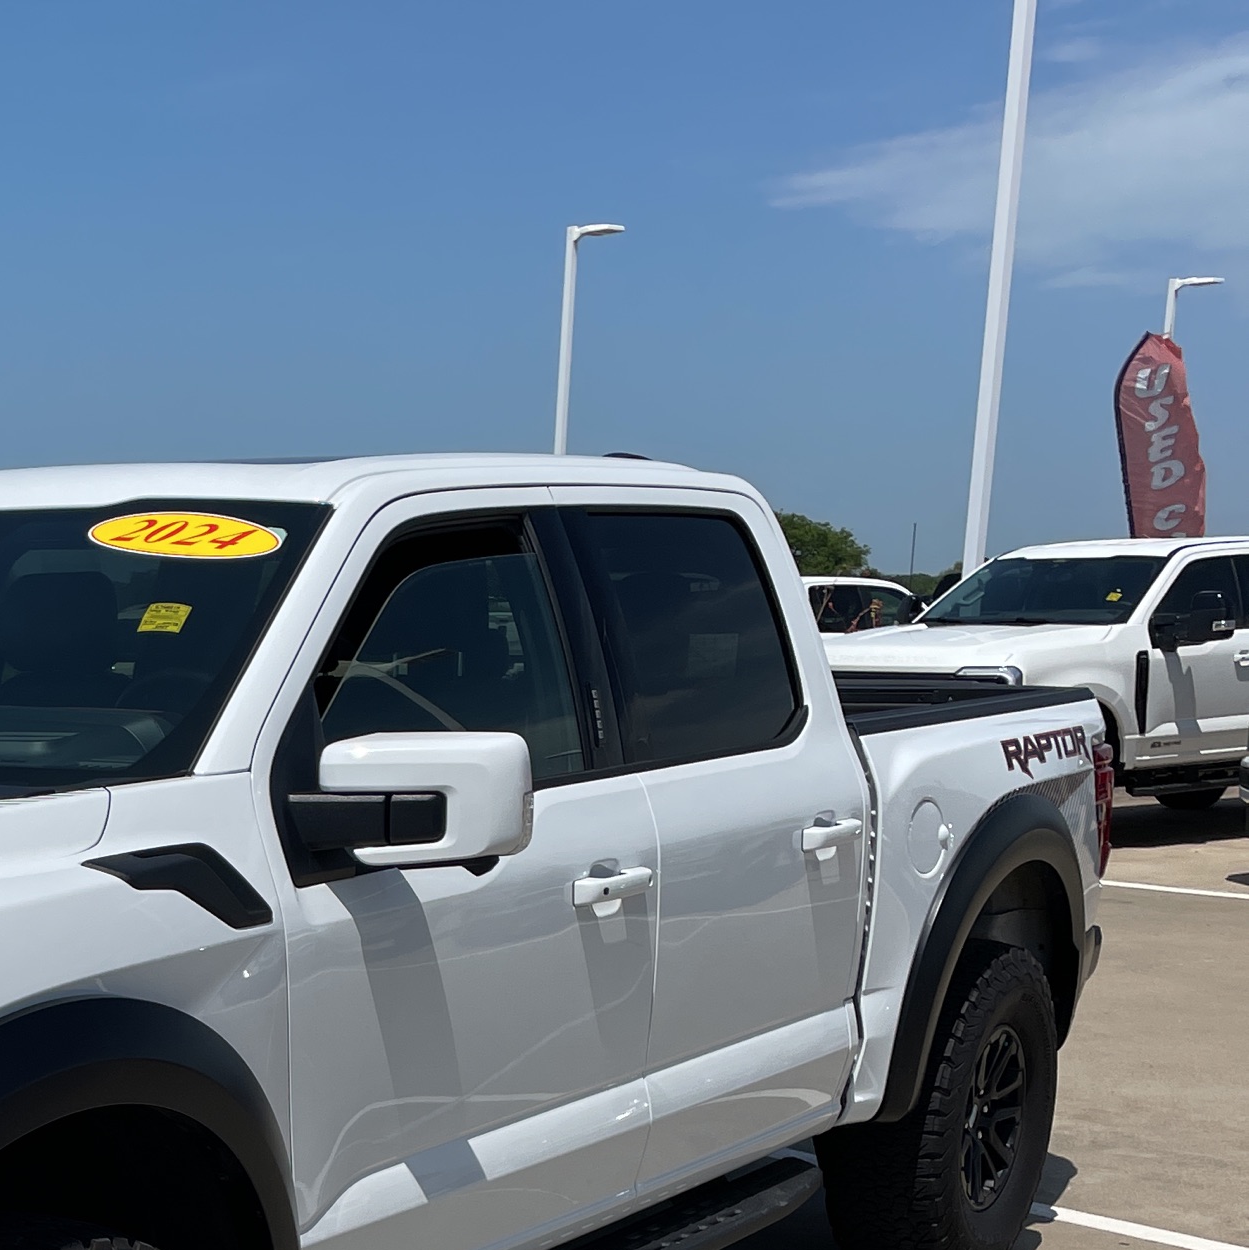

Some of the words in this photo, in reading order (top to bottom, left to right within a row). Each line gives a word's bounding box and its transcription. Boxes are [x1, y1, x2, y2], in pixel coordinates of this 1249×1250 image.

[1134, 362, 1185, 490] USED
[108, 519, 259, 549] 2024
[1000, 726, 1094, 780] RAPTOR
